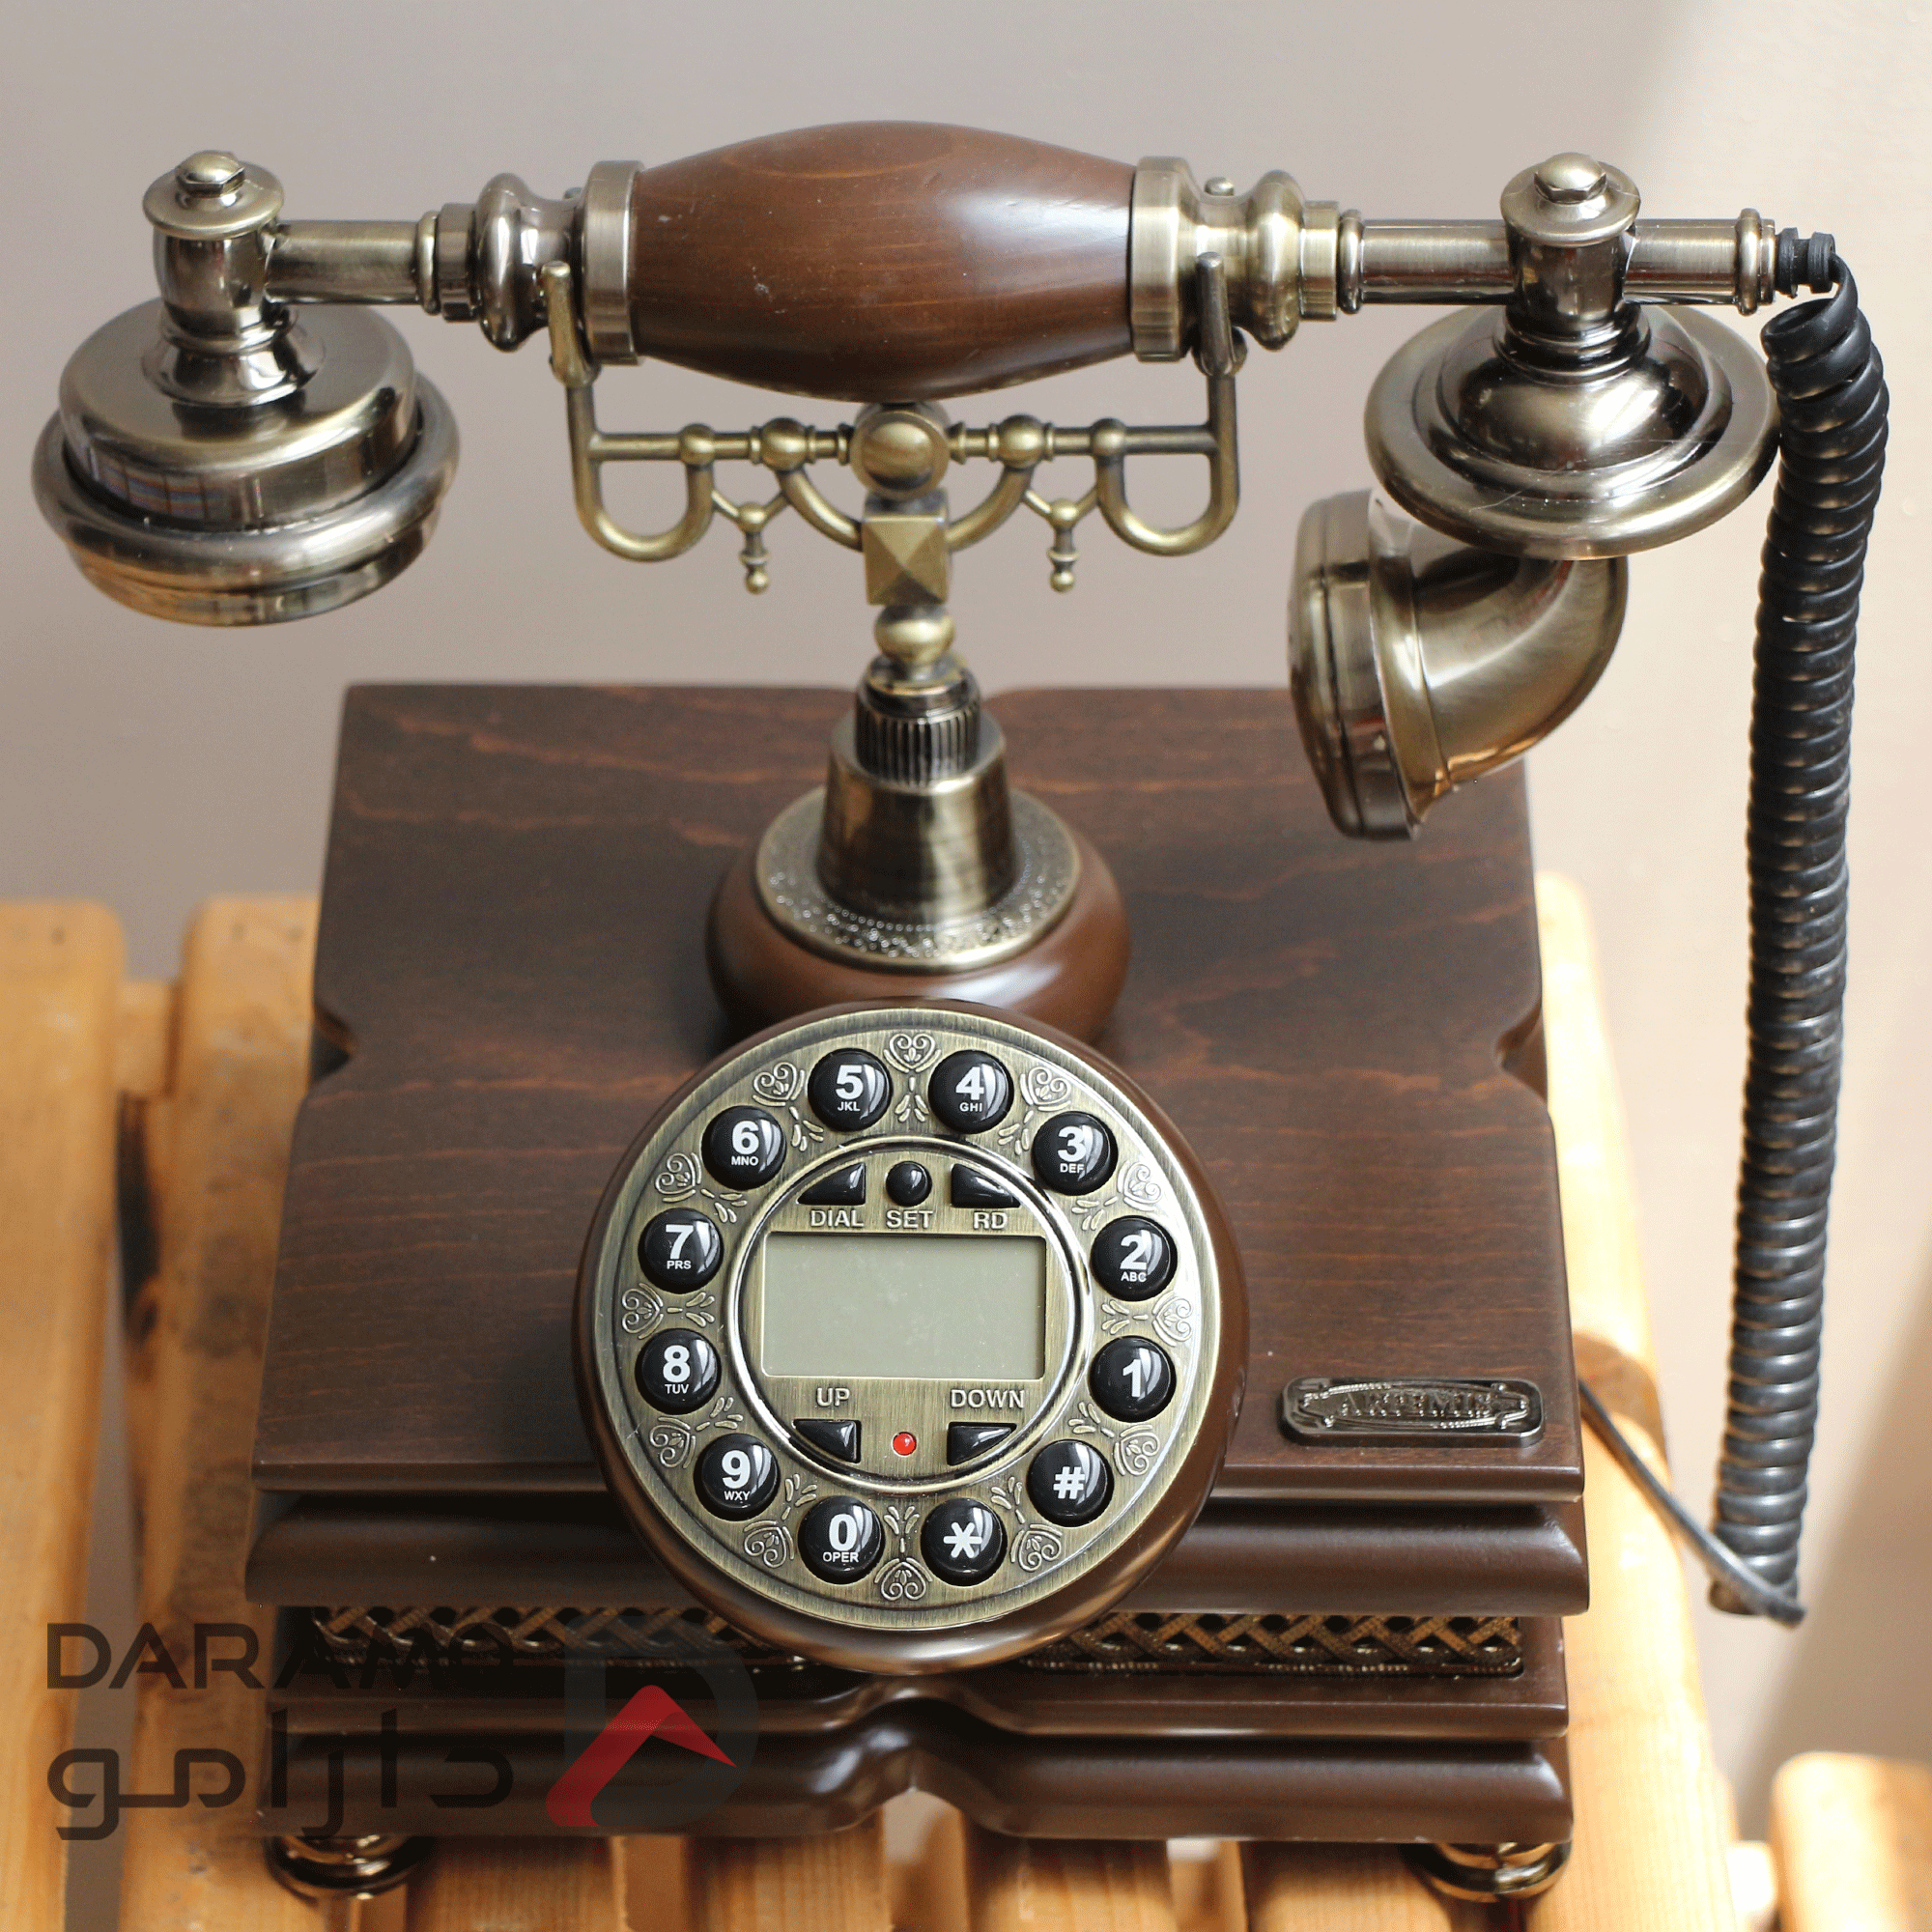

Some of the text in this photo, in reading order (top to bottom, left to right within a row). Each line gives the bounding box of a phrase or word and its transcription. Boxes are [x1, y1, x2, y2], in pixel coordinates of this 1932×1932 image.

[835, 1065, 864, 1099] 5
[955, 1065, 984, 1100] 4
[837, 1101, 861, 1112] JKL
[959, 1101, 983, 1113] GHI
[731, 1121, 759, 1154] 6
[1057, 1125, 1086, 1162] 3
[730, 1155, 759, 1166] MNO
[1060, 1162, 1085, 1174] DEF
[810, 1209, 865, 1229] DIAL
[885, 1210, 933, 1230] SET
[973, 1211, 1009, 1230] RD
[665, 1224, 695, 1260] 7
[1120, 1234, 1148, 1270] 2
[667, 1260, 692, 1270] PRS
[1121, 1271, 1148, 1283] ABC
[663, 1345, 691, 1382] 8
[1122, 1358, 1142, 1398] 1
[665, 1383, 690, 1394] TUV
[816, 1387, 851, 1407] UP
[951, 1389, 1025, 1408] DOWN
[721, 1449, 752, 1489] 9
[724, 1491, 751, 1501] WXY
[828, 1514, 858, 1551] 0
[822, 1551, 860, 1563] OPER
